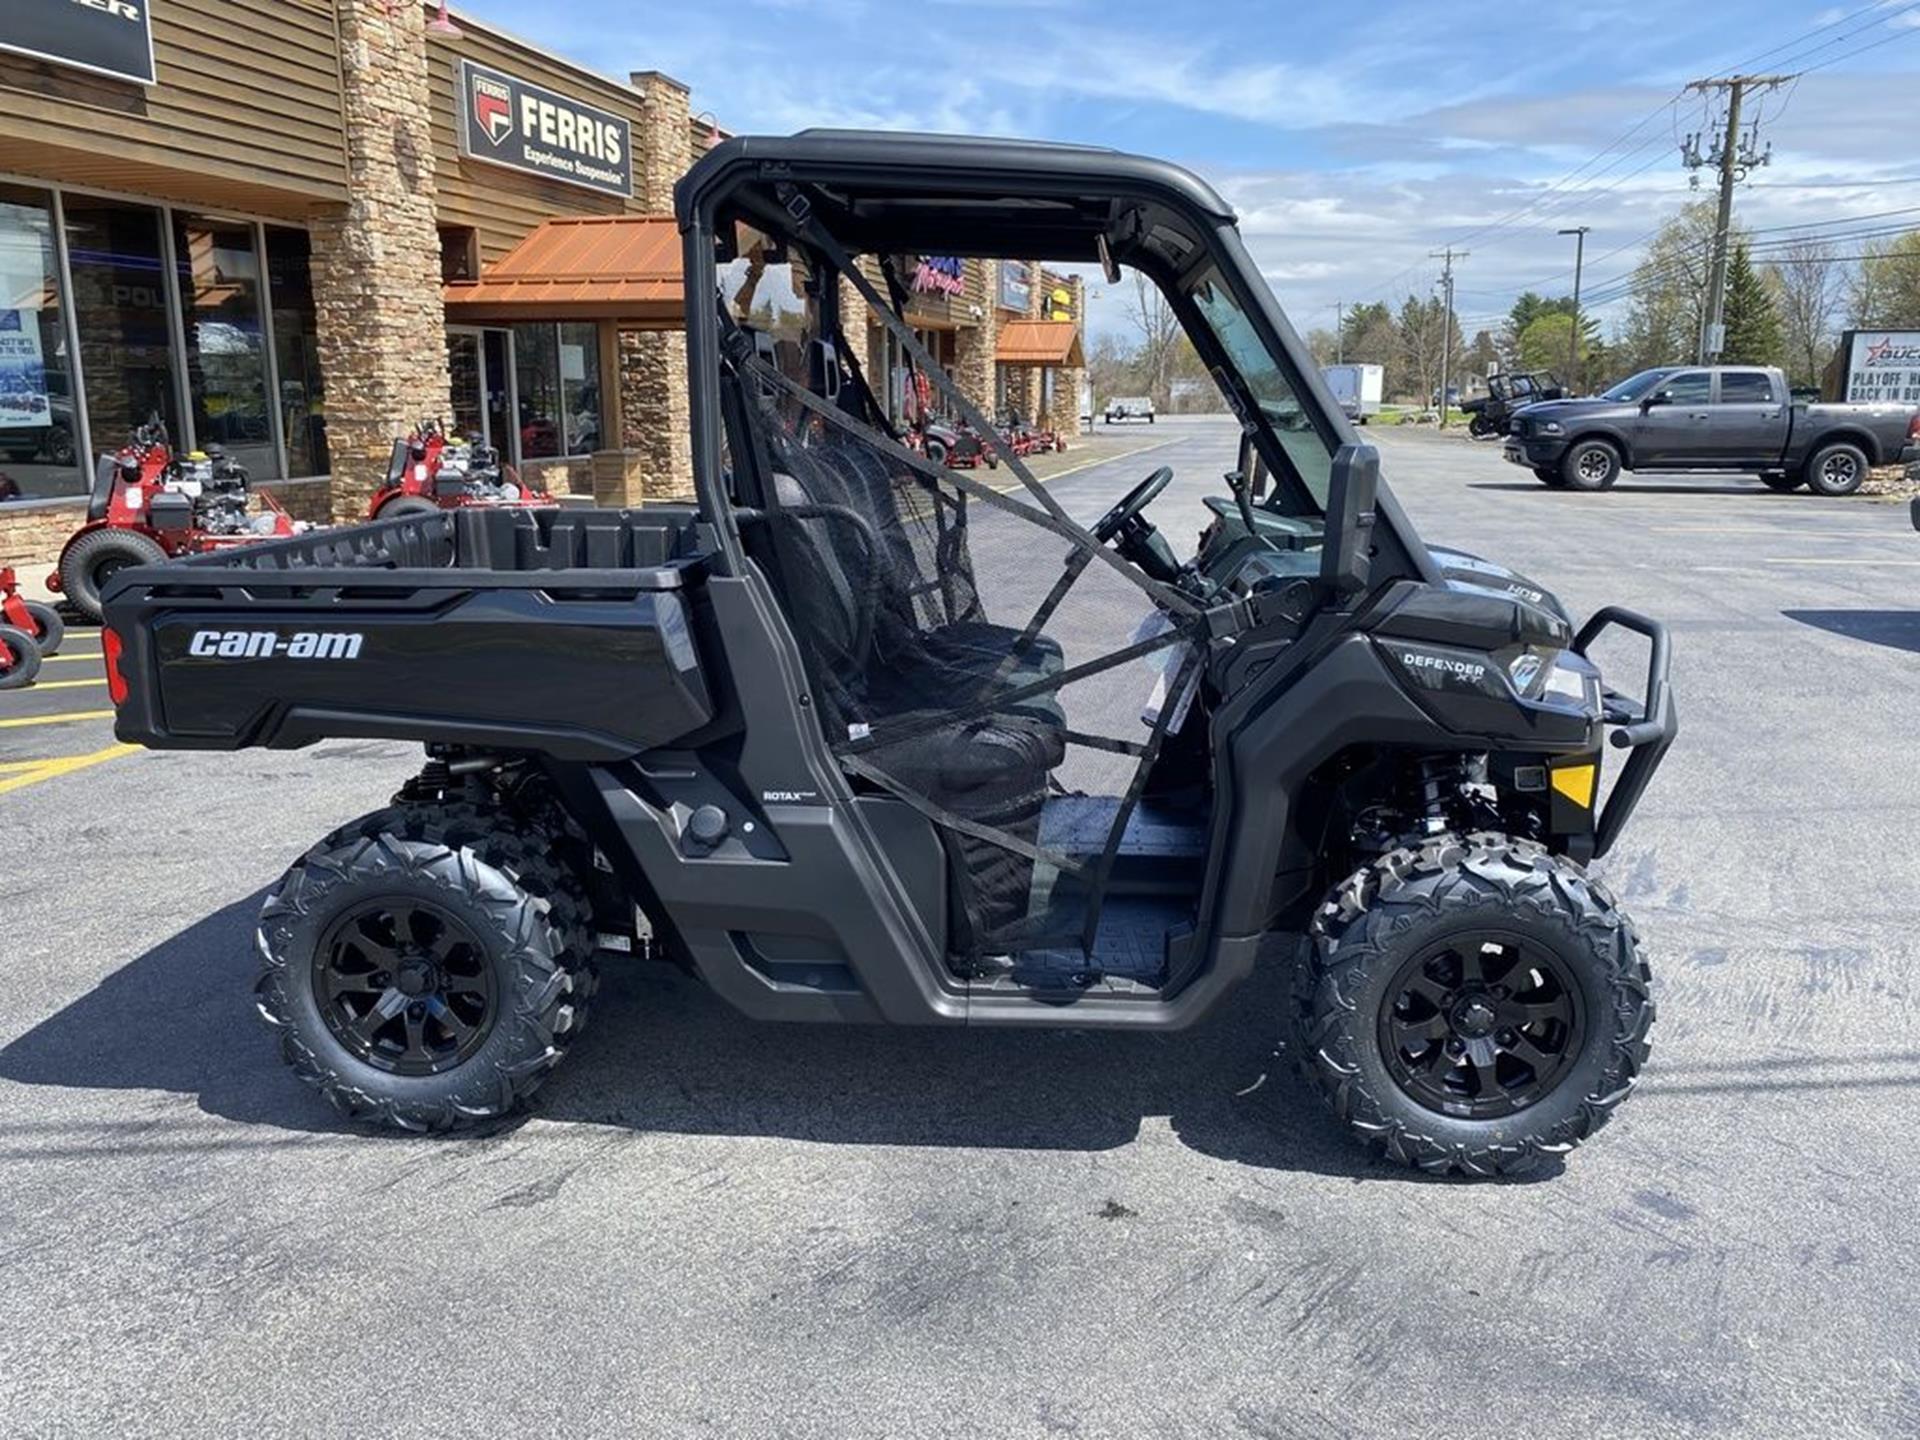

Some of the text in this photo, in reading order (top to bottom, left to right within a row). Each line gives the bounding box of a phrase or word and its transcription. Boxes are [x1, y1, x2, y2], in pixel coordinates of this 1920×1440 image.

[521, 94, 621, 164] FERRIS
[523, 144, 622, 185] Experience Suspension
[112, 285, 167, 308] POL
[1853, 373, 1900, 386] PLAYOFF
[1850, 388, 1920, 401] BACK IN BU
[190, 630, 363, 659] can-am
[1404, 654, 1485, 675] DEFENDER
[1456, 673, 1482, 684] XT
[763, 791, 801, 801] ROTAX
